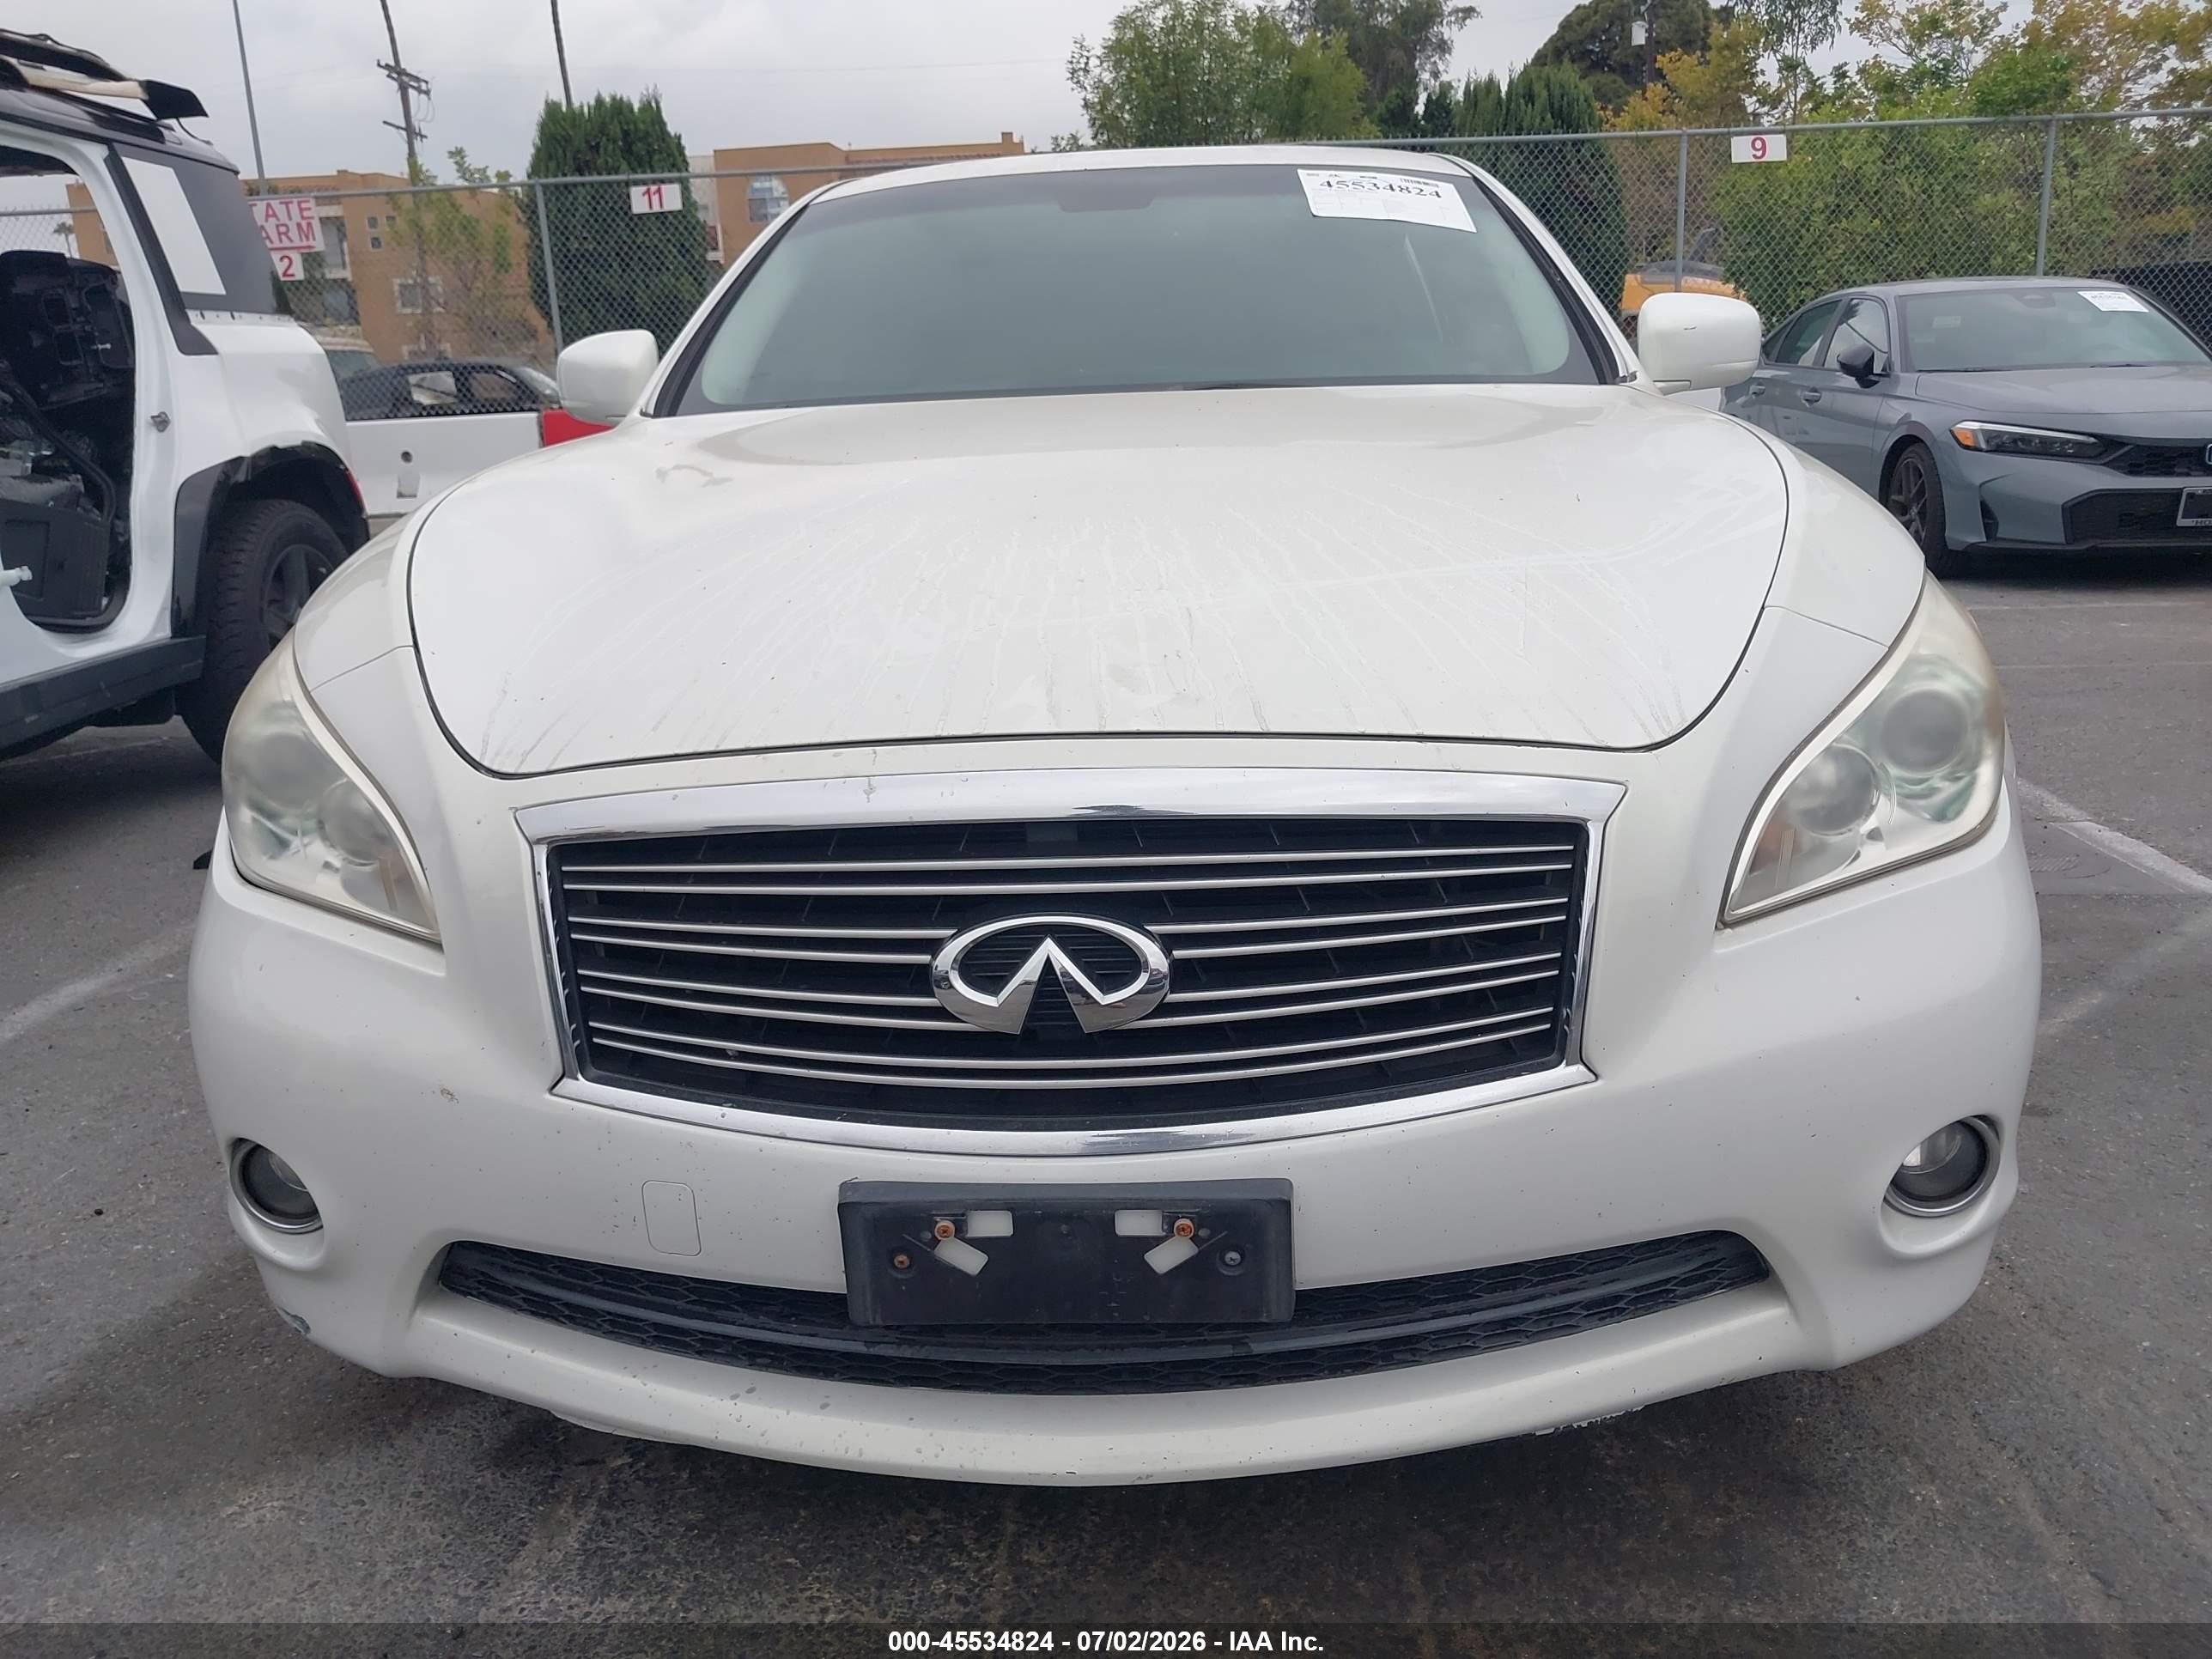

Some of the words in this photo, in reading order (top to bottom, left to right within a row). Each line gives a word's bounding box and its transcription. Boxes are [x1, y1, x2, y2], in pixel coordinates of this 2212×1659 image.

[1751, 137, 1767, 160] 9
[641, 185, 664, 210] 11
[1319, 179, 1442, 198] 45534824
[279, 255, 295, 278] 2
